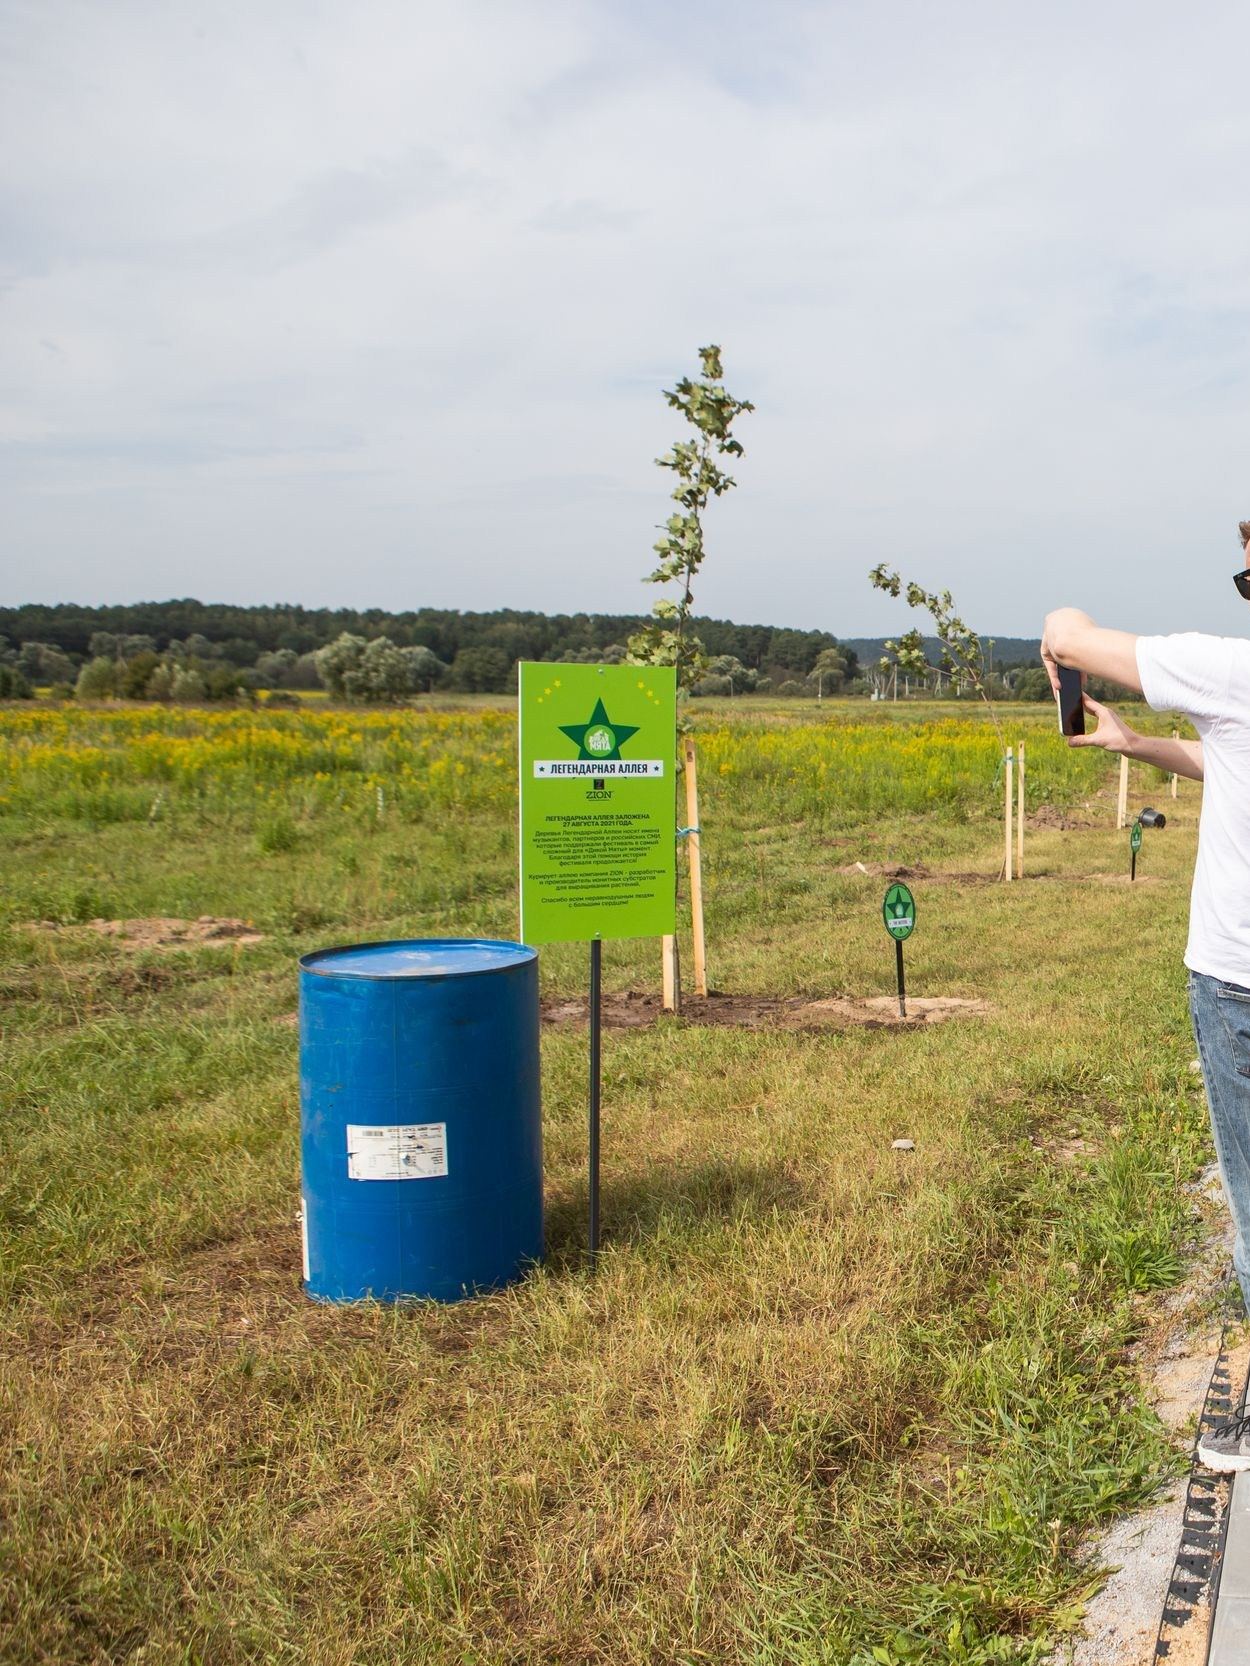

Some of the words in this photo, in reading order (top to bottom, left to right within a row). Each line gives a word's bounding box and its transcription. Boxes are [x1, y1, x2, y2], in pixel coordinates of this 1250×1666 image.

[550, 763, 615, 775] ЛЕГЕНДАРНАЯ
[618, 763, 648, 773] АЛЛЕЯ
[586, 791, 612, 799] ZION
